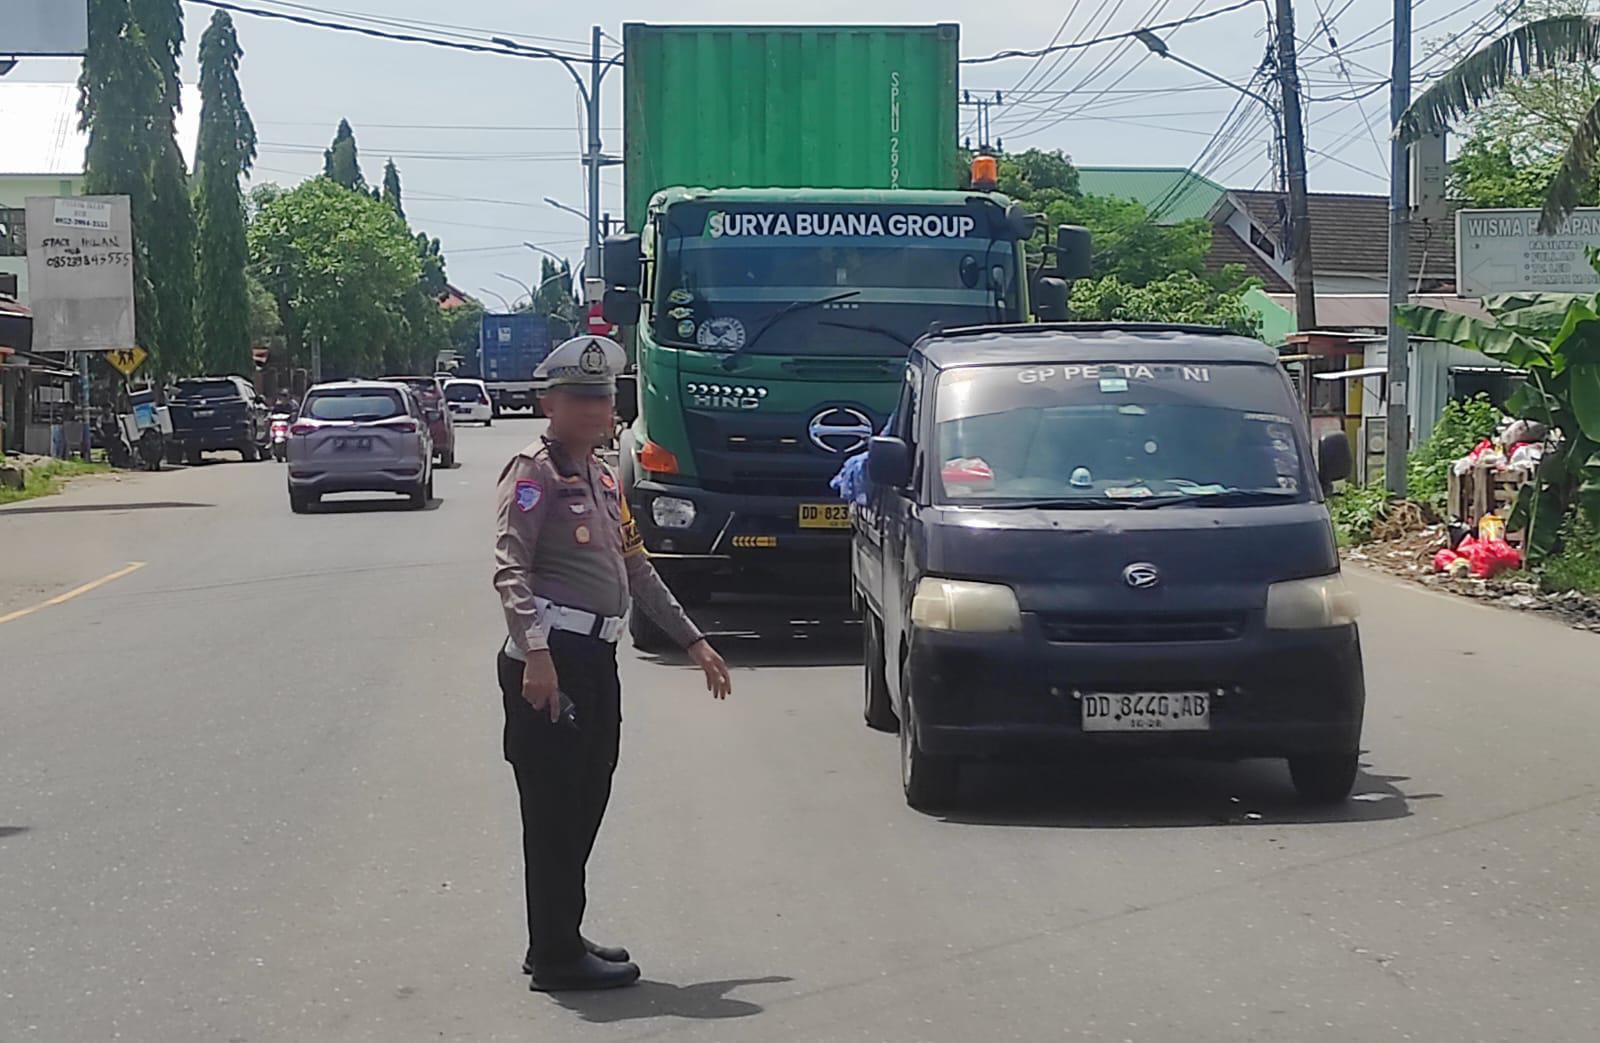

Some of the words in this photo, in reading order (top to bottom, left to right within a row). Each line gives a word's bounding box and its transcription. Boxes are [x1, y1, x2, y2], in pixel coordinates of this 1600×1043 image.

[891, 71, 900, 133] SPNU
[708, 211, 793, 239] SURYA
[796, 213, 885, 237] BUANA
[888, 214, 975, 238] GROUP
[1468, 217, 1522, 237] WISMA
[1527, 217, 1600, 236] HAPAN
[1016, 367, 1056, 384] GP
[693, 394, 760, 409] HINO
[802, 505, 818, 520] DD
[1085, 696, 1111, 718] DD
[1181, 695, 1206, 717] AB
